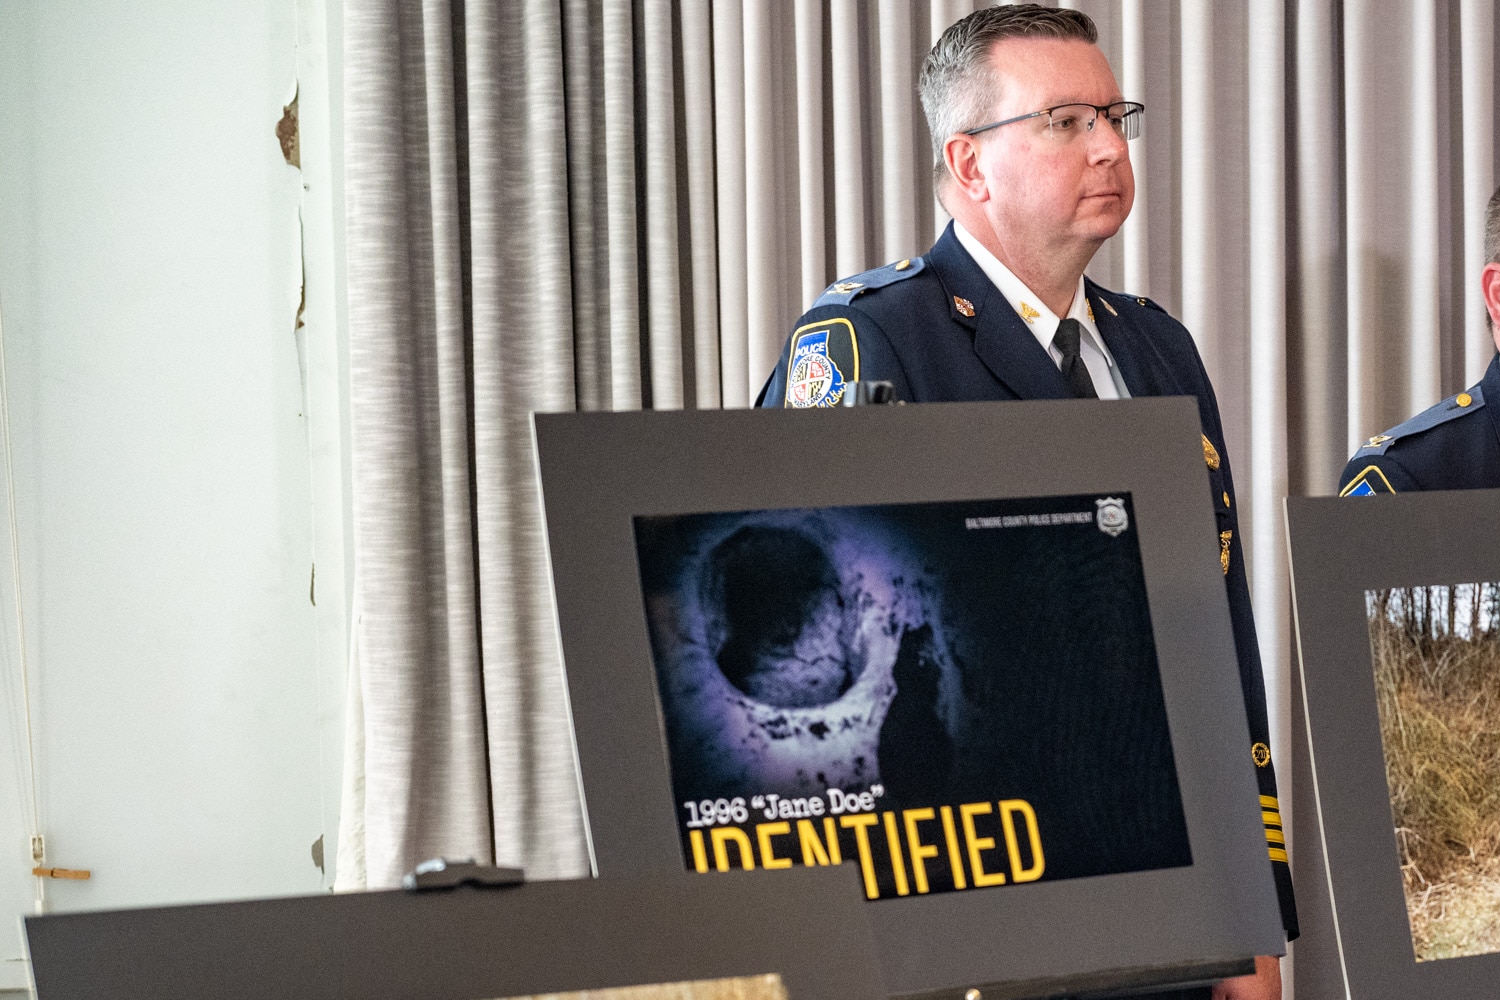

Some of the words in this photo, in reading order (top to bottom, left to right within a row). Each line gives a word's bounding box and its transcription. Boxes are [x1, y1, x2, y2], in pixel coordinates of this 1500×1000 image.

[795, 342, 825, 358] POLICE
[814, 355, 831, 380] COUNTY
[965, 517, 1002, 529] BALTIMORE
[1002, 515, 1027, 527] COUNTY
[1028, 514, 1050, 526] POLICE
[1051, 512, 1092, 523] DEPARTMENT
[684, 799, 749, 828] 1996
[689, 799, 1045, 899] IDENTIFIED
